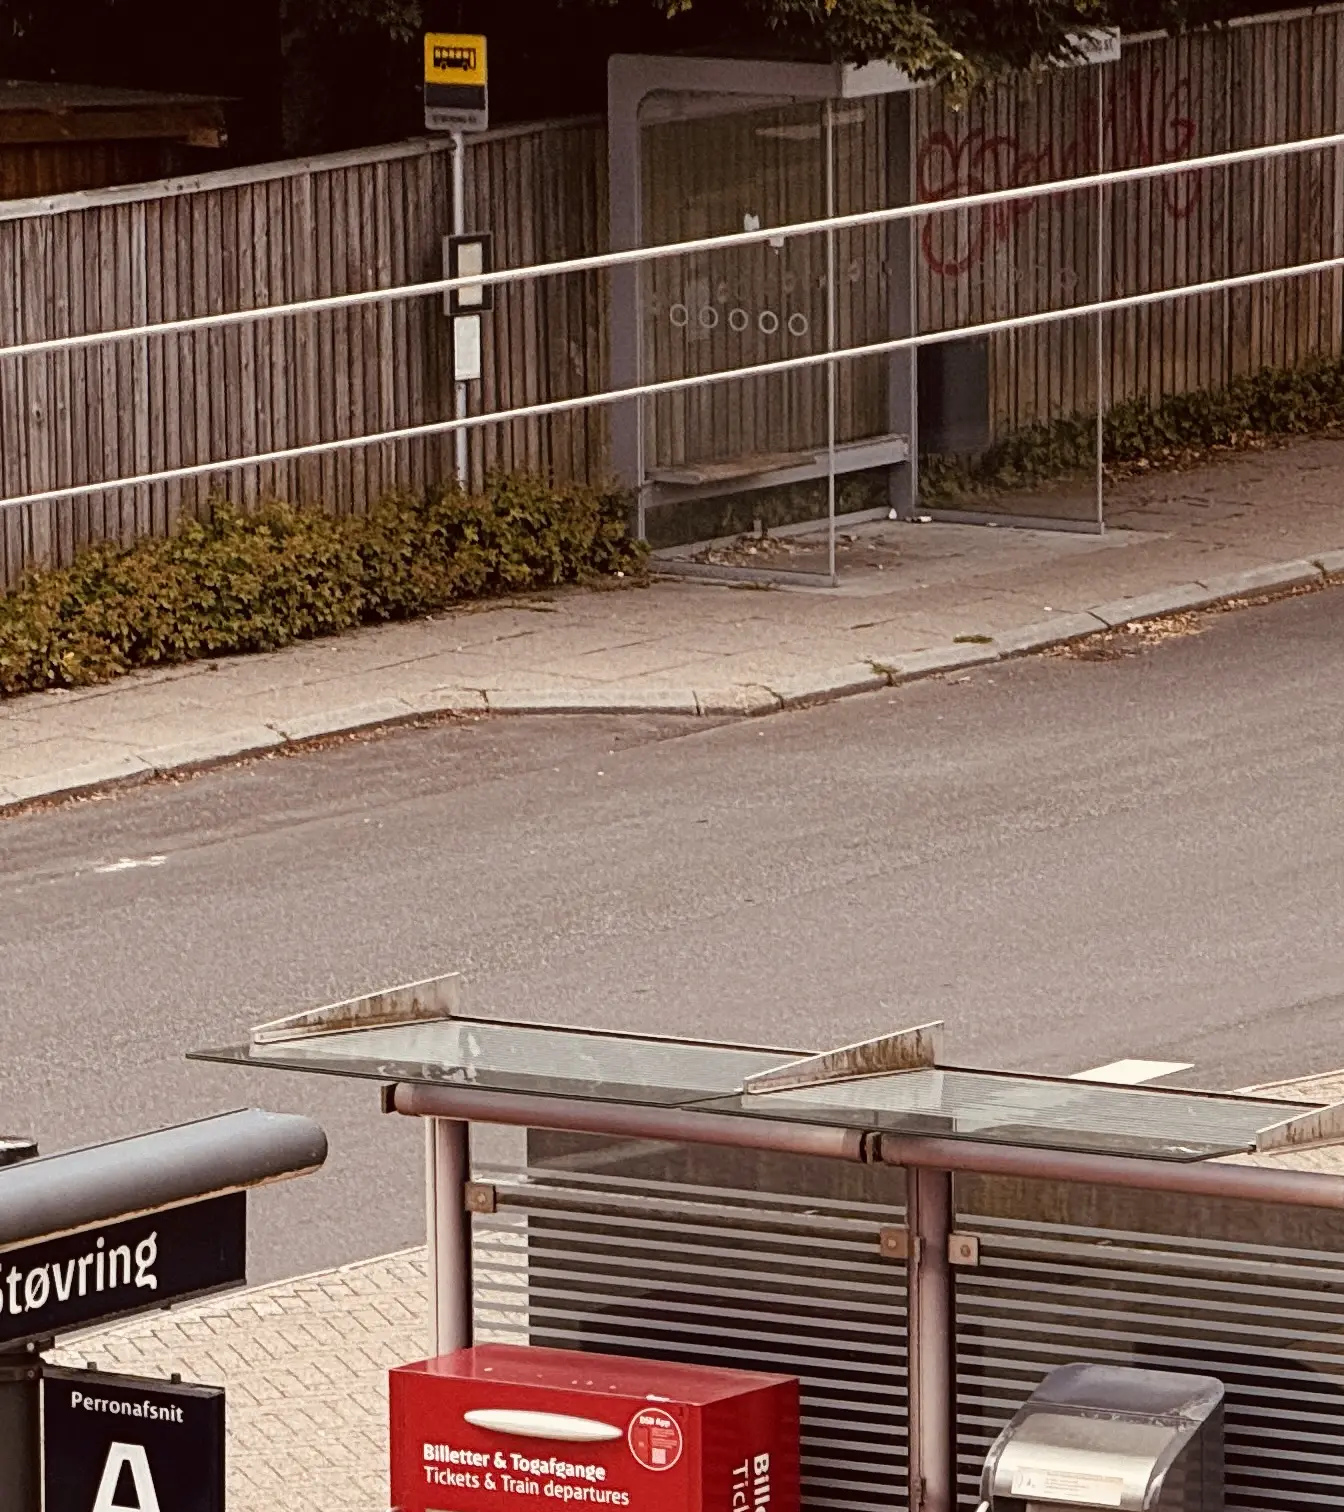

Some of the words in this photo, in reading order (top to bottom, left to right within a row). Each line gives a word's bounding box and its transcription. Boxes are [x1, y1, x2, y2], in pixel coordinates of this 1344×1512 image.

[0, 1231, 157, 1314] tøvring
[71, 1391, 184, 1423] Perronafsnit
[423, 1443, 490, 1467] Billetter
[493, 1451, 507, 1469] &
[510, 1453, 606, 1482] Togafgange
[424, 1466, 480, 1489] Tickets
[484, 1472, 497, 1490] &
[501, 1474, 539, 1495] Train
[544, 1480, 630, 1505] departures
